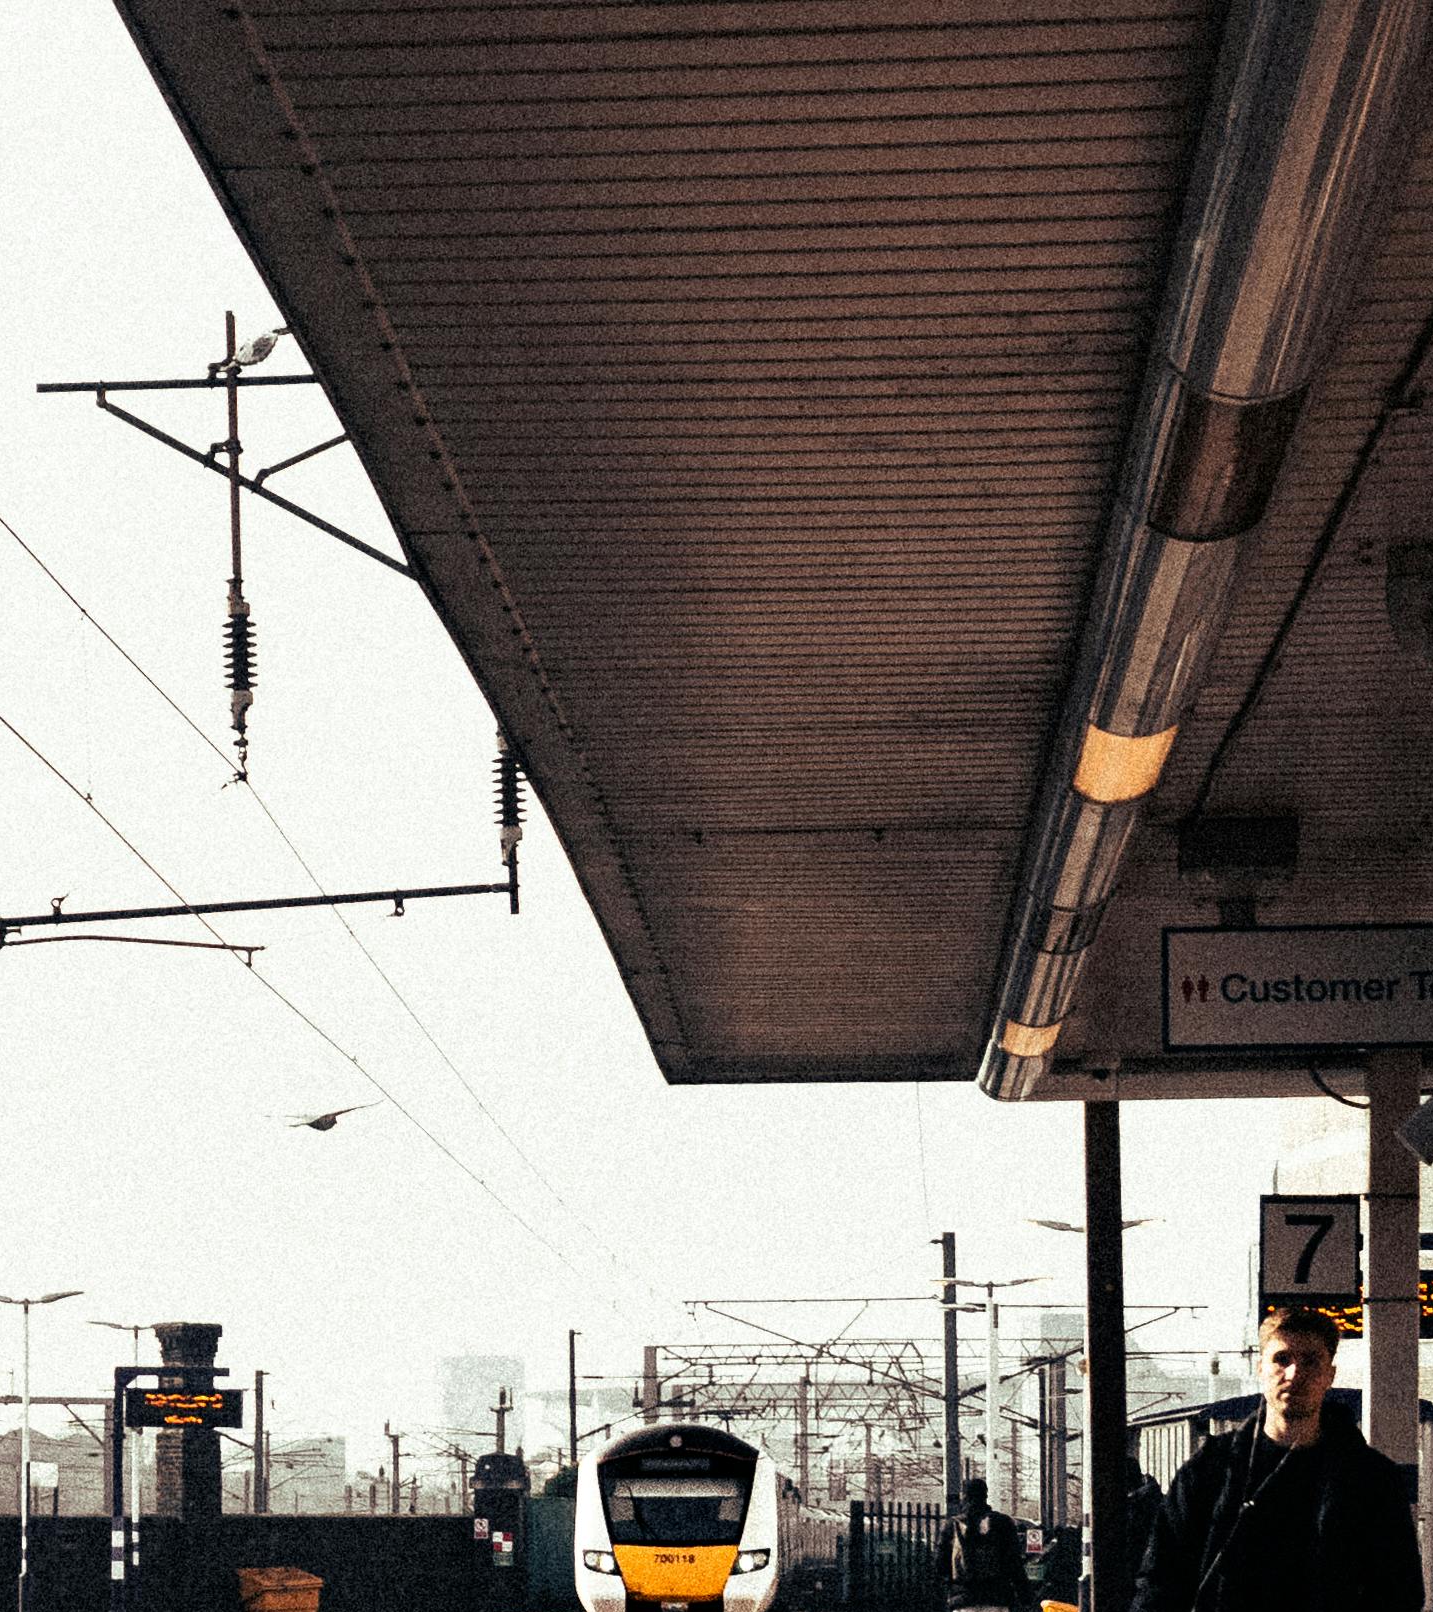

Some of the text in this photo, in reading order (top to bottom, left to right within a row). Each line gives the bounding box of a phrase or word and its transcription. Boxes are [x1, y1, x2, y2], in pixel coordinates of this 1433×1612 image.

[1220, 973, 1399, 1003] Customer
[1285, 1213, 1335, 1284] 7
[653, 1553, 696, 1564] 700118
